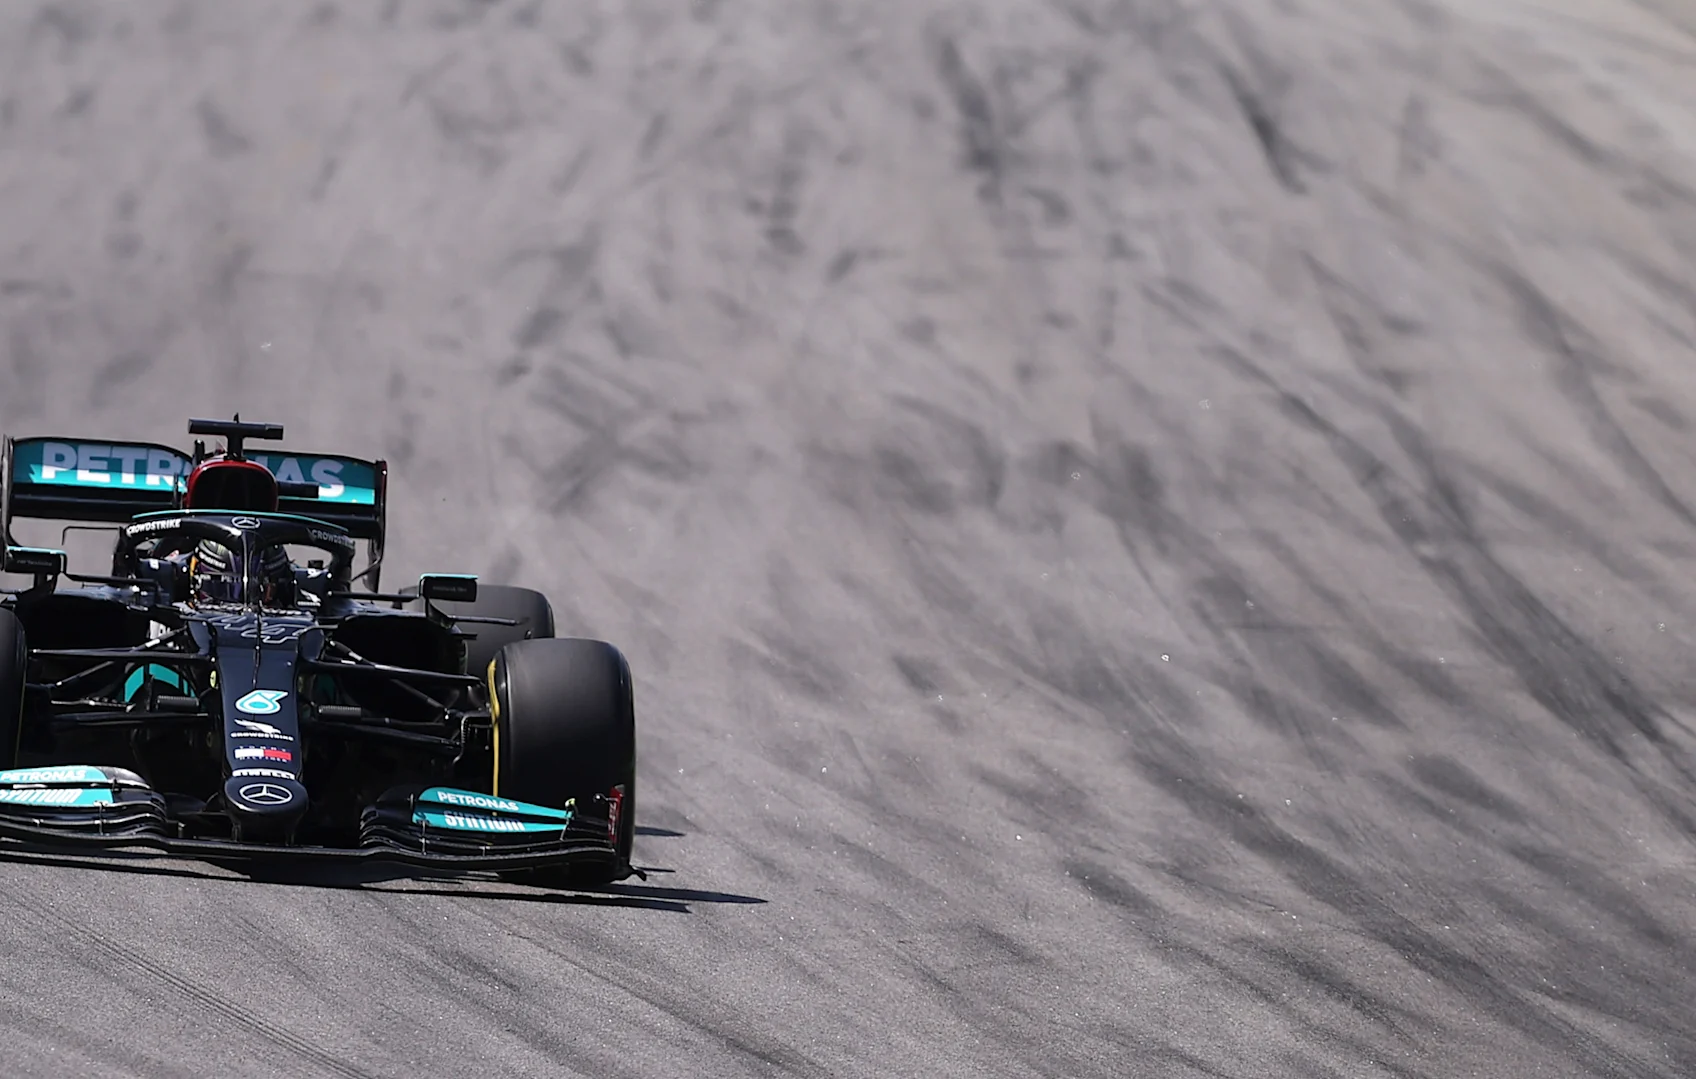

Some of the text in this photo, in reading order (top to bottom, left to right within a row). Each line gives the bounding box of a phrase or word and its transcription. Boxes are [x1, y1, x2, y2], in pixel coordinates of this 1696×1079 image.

[41, 440, 345, 498] PETRAS
[126, 519, 181, 537] CROWDSTRIKE
[0, 771, 86, 782] PETRONAS
[436, 790, 520, 812] PETRONAS
[444, 810, 526, 832] SYNTIUM
